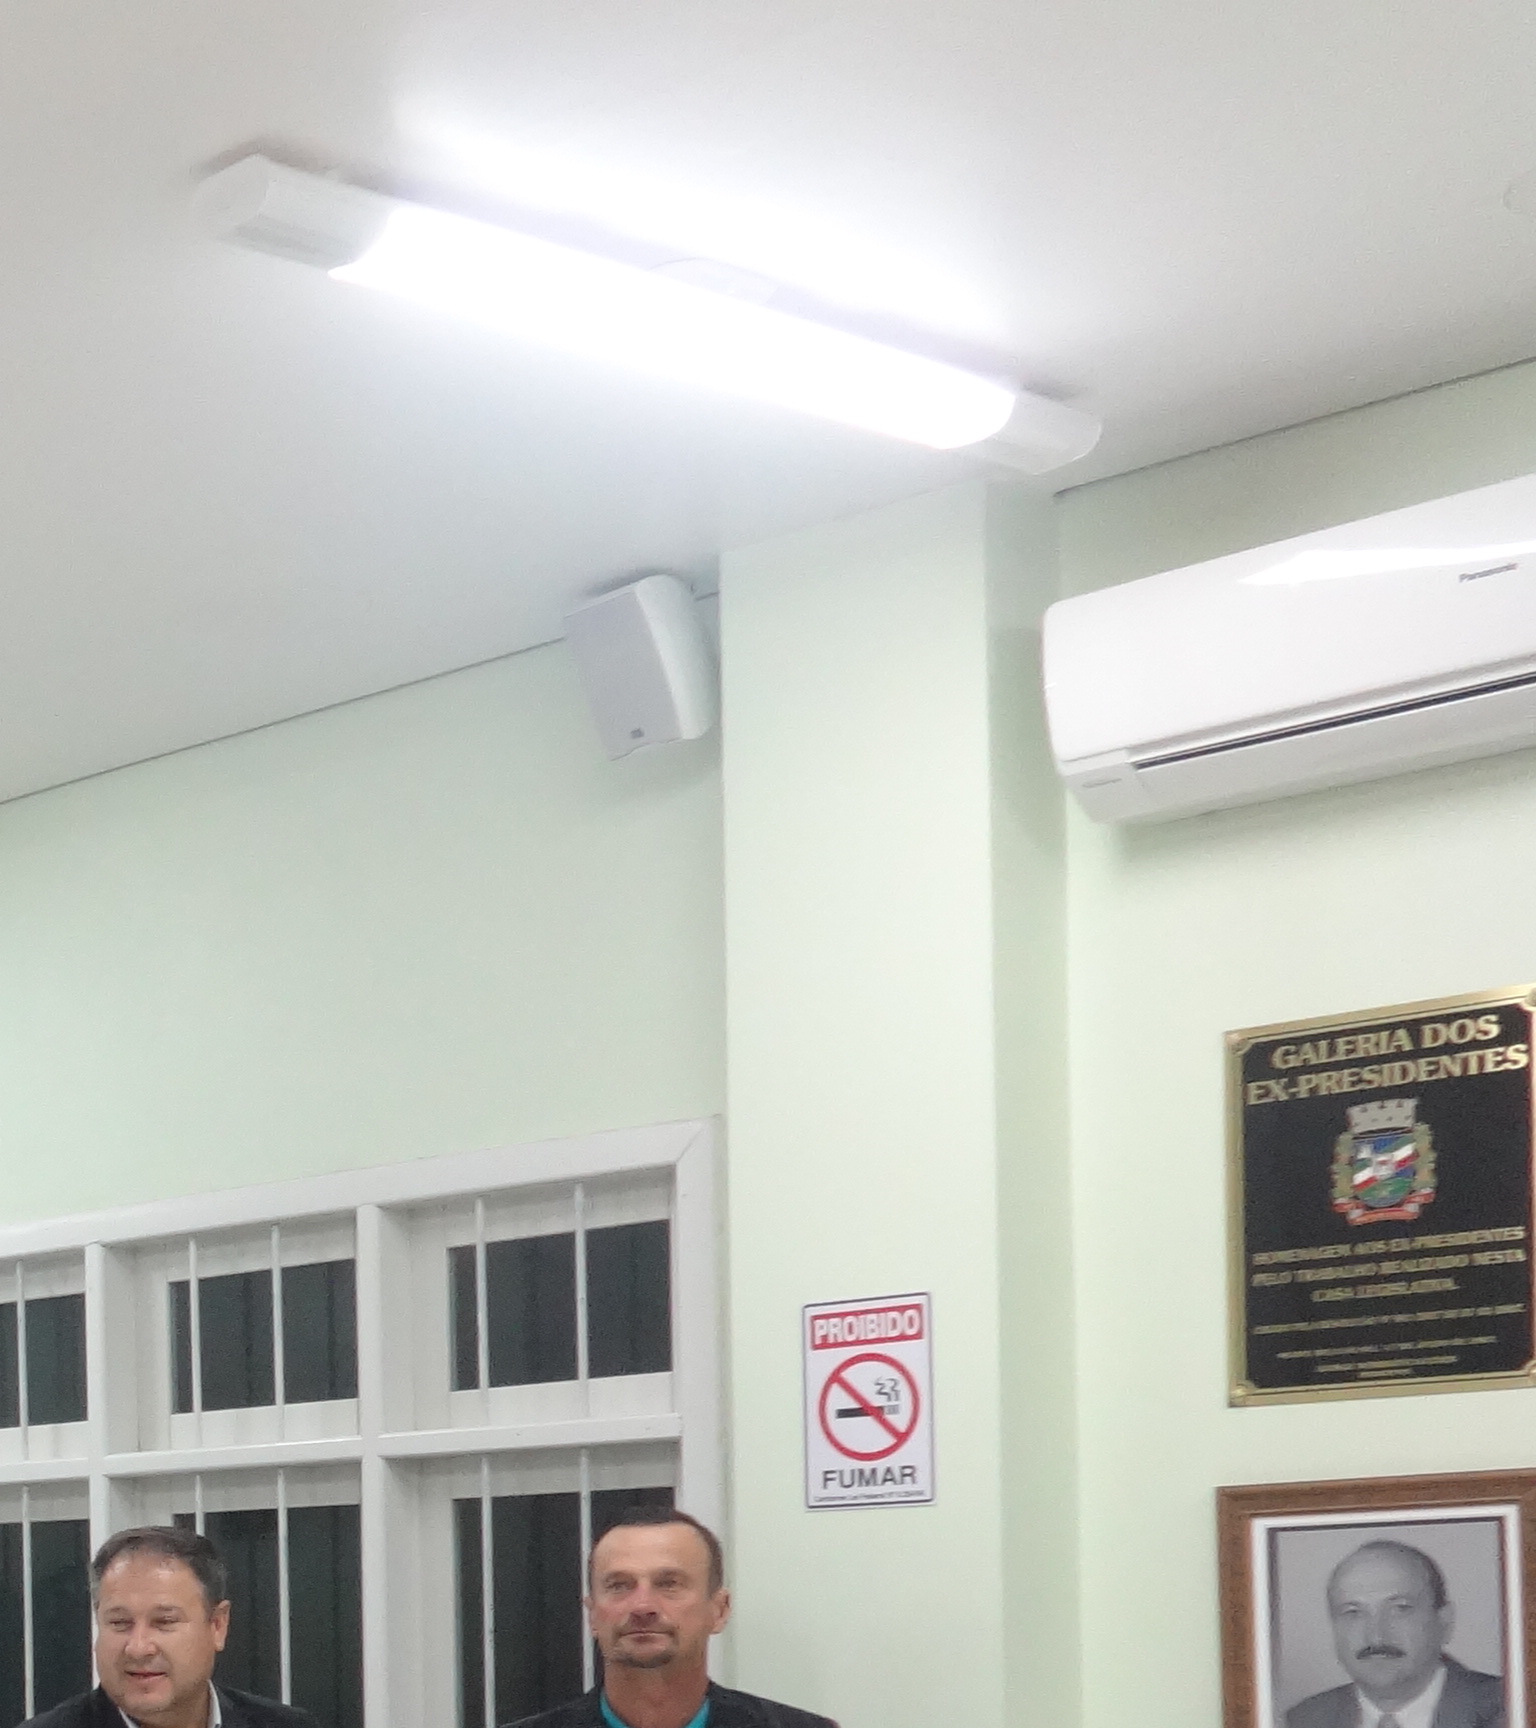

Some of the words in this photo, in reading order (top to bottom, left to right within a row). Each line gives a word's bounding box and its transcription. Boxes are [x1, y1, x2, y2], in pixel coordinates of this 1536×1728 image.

[1271, 1028, 1414, 1070] GALERIA
[1420, 1014, 1502, 1049] DOS
[1245, 1043, 1529, 1105] EX-PRESIDENTES
[813, 1309, 921, 1345] PROIBIDO
[822, 1465, 917, 1489] FUMAR
